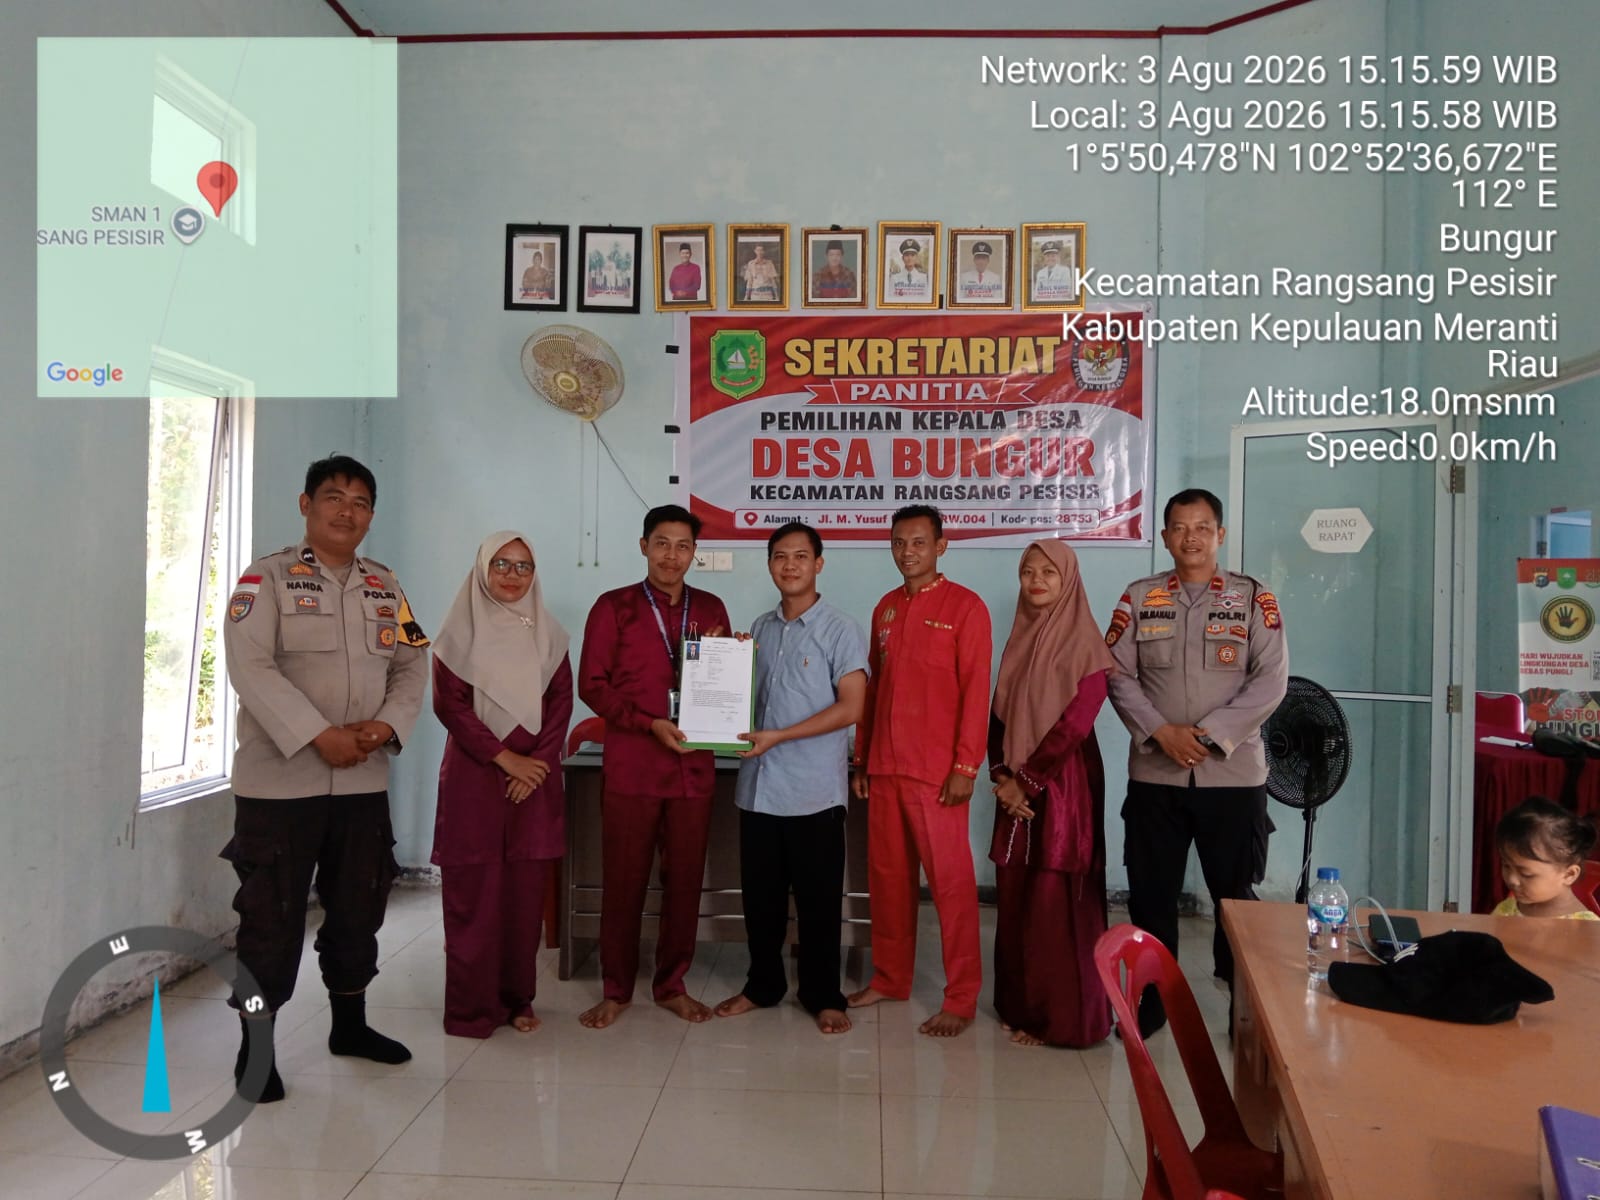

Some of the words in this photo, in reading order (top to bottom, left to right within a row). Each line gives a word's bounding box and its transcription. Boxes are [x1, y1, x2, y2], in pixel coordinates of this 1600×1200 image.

[784, 336, 1061, 376] SEKRETARIAT
[850, 382, 989, 401] PANITIA
[760, 411, 902, 431] PEMILIHAN
[912, 410, 1007, 430] KEPALA
[1017, 409, 1083, 429] DESA
[752, 437, 876, 479] DESA
[892, 436, 1096, 478] BUNGUR
[750, 484, 884, 500] KECAMATAN
[894, 484, 1011, 500] RANGSANG
[1019, 483, 1100, 500] PESISIR
[763, 514, 802, 524] Alamat
[817, 514, 831, 525] Jl.
[836, 514, 851, 525] M.
[854, 513, 888, 524] Yusuf
[1001, 514, 1026, 525] Kode
[1055, 513, 1093, 525] 28753
[1316, 518, 1358, 529] RUANG
[1318, 531, 1356, 542] RAPAT
[363, 590, 397, 601] POLRI
[1208, 611, 1246, 622] POLRI
